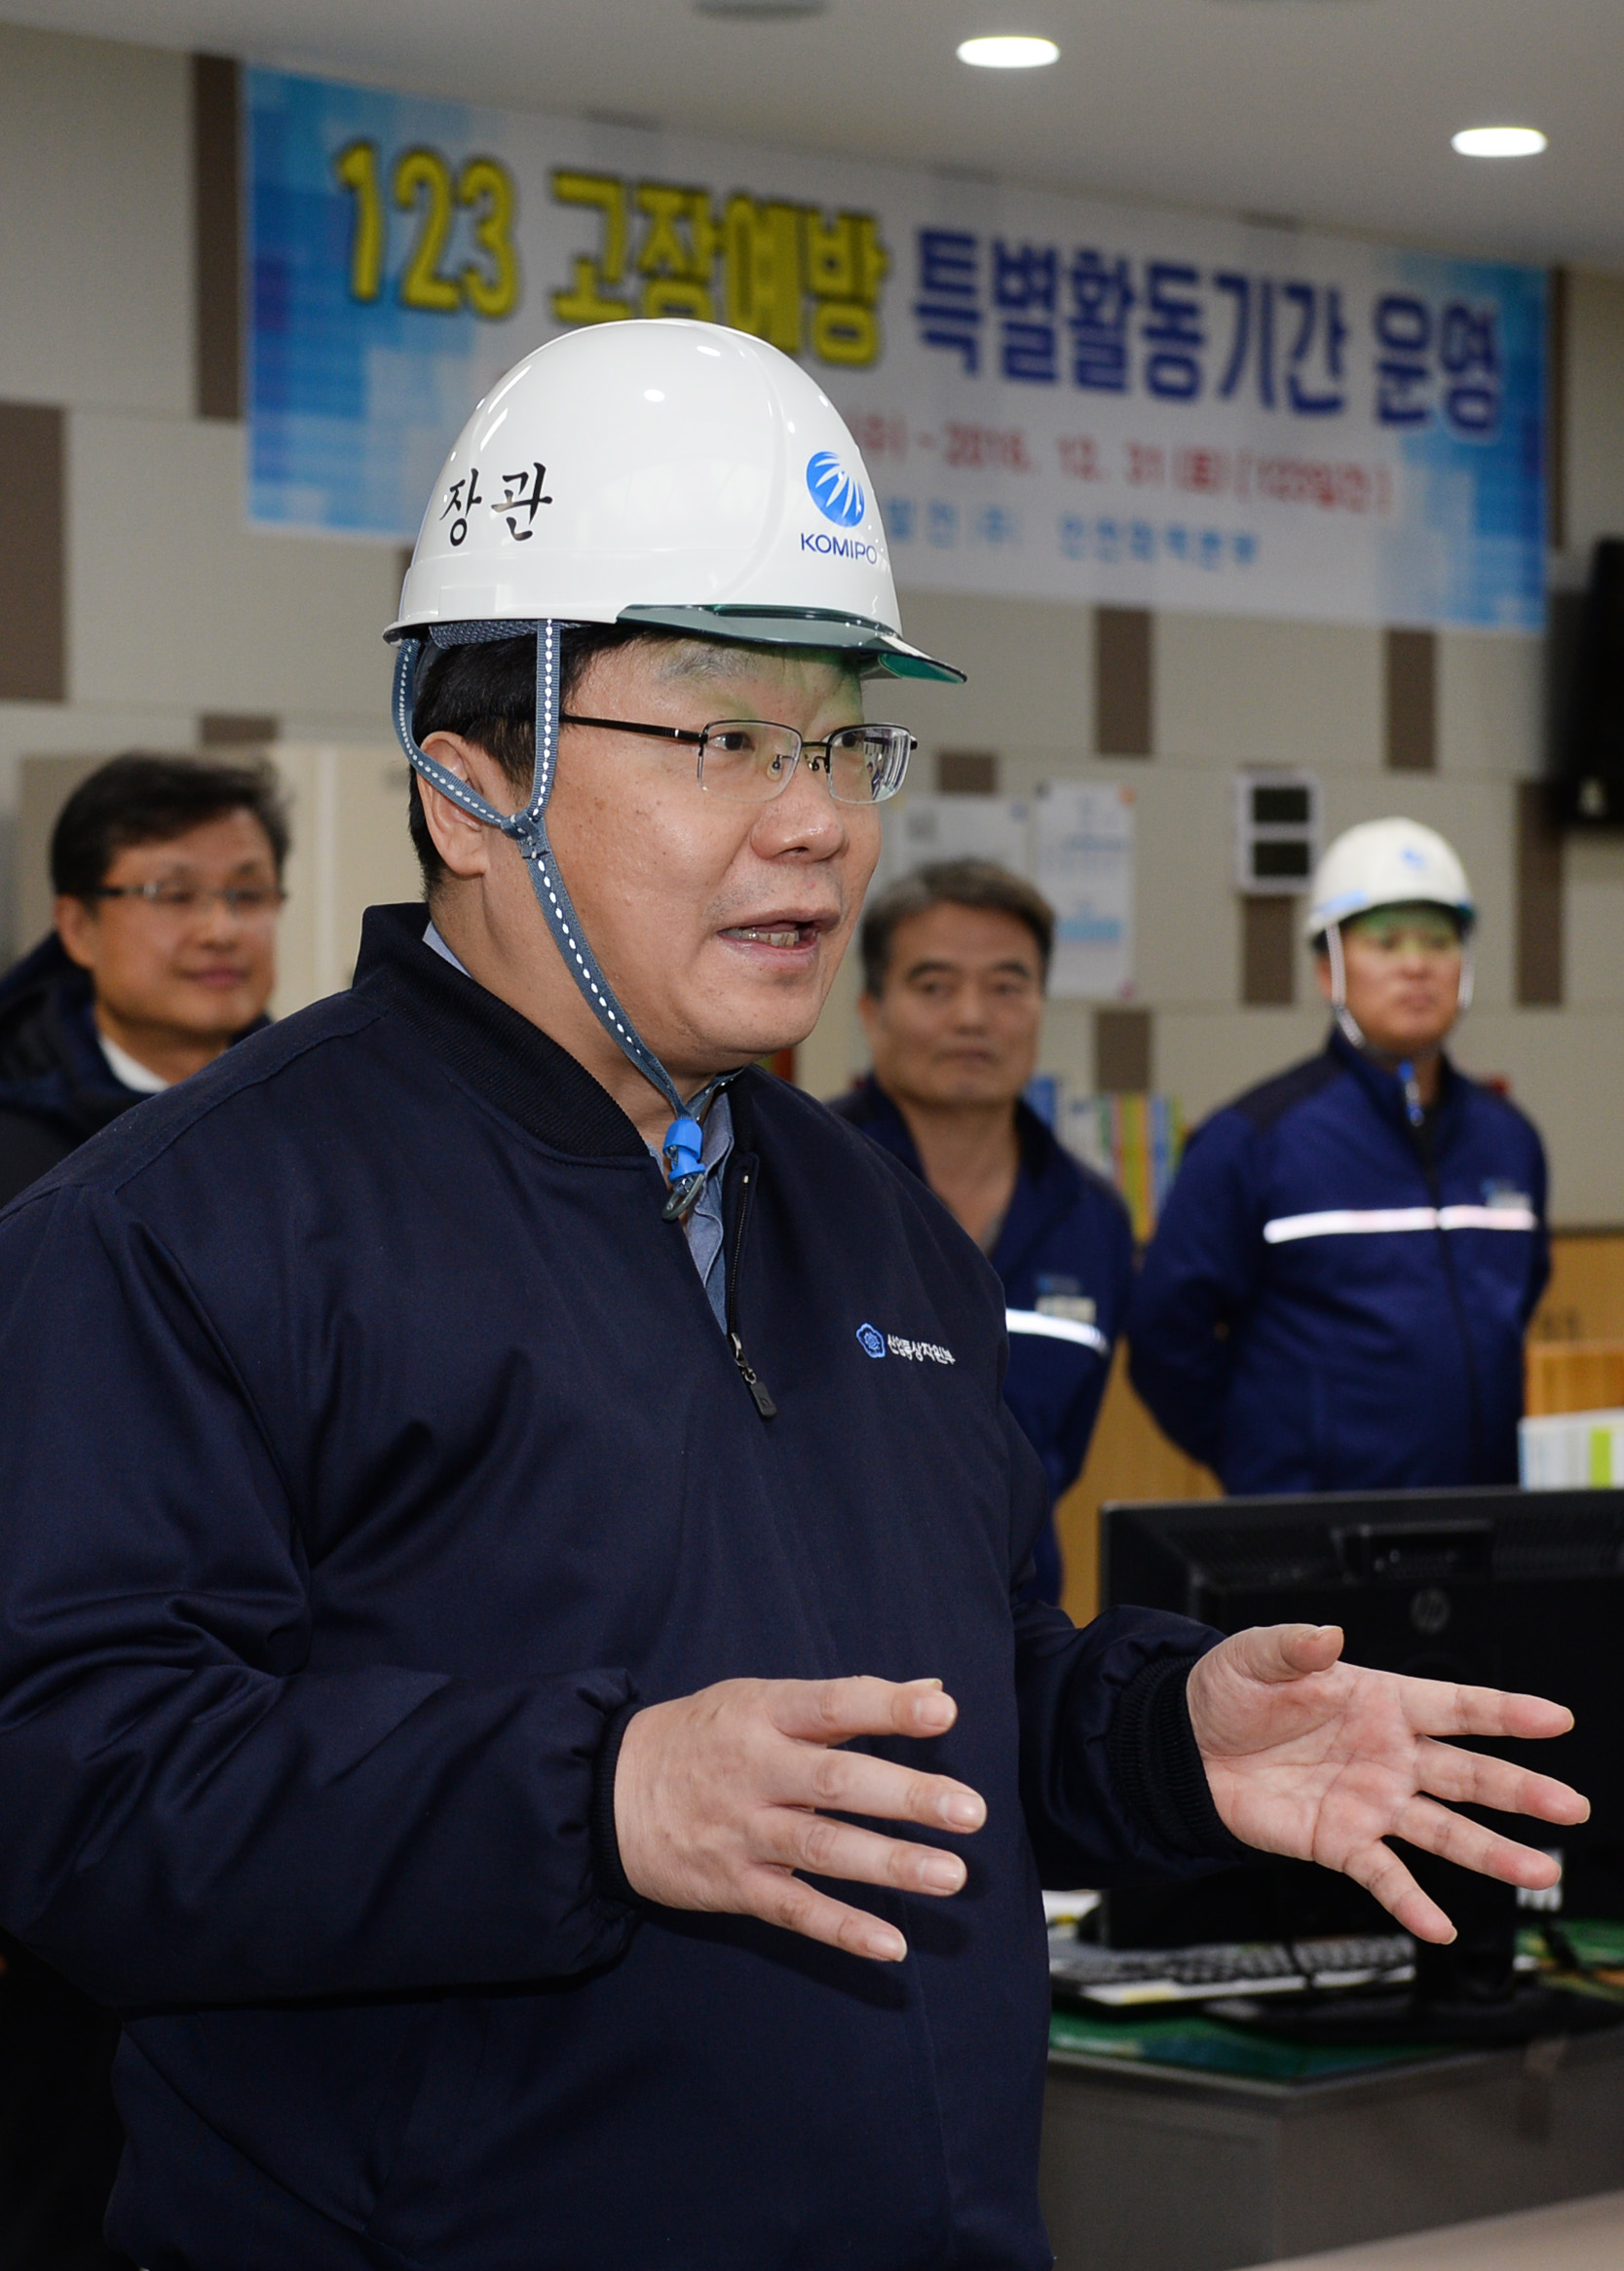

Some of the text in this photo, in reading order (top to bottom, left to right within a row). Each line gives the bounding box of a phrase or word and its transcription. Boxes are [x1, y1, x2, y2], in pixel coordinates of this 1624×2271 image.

[337, 140, 1503, 437] 123 고장예방 특별활동기간 운영
[439, 462, 552, 547] 장관
[801, 532, 877, 565] KOMIPO
